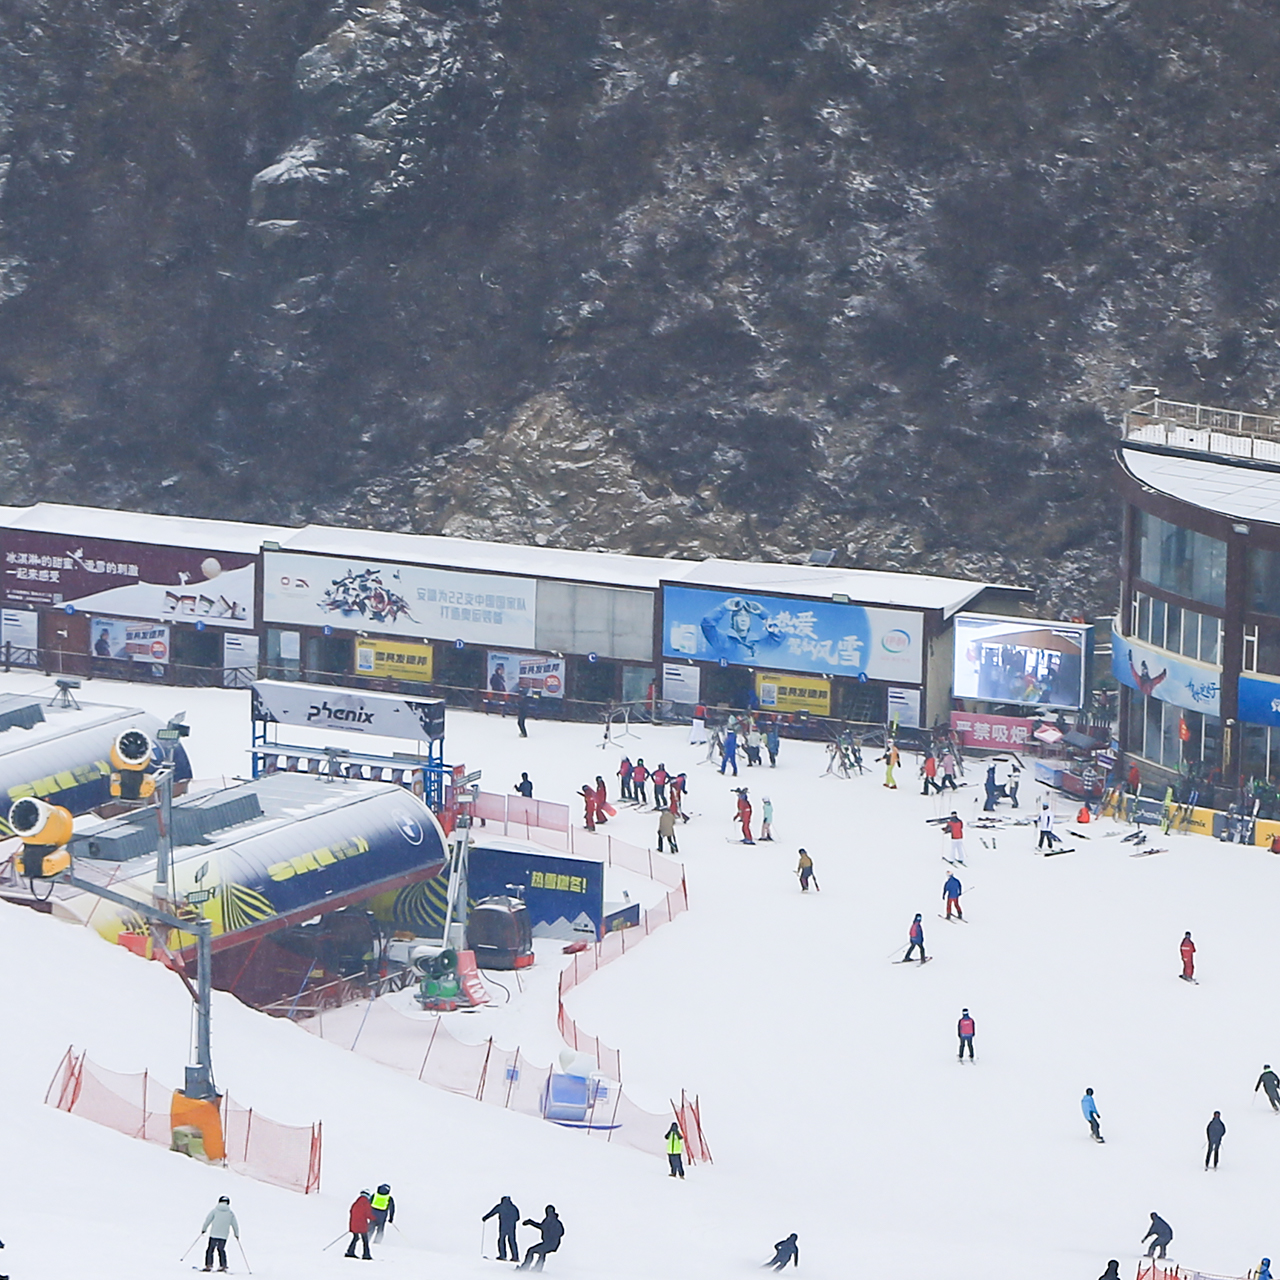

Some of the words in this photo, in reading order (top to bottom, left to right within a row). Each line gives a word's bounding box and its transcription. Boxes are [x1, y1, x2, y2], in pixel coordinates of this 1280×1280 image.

[5, 567, 60, 583] 一起来感受
[306, 700, 375, 724] phenix
[955, 720, 1028, 745] 严禁吸烟
